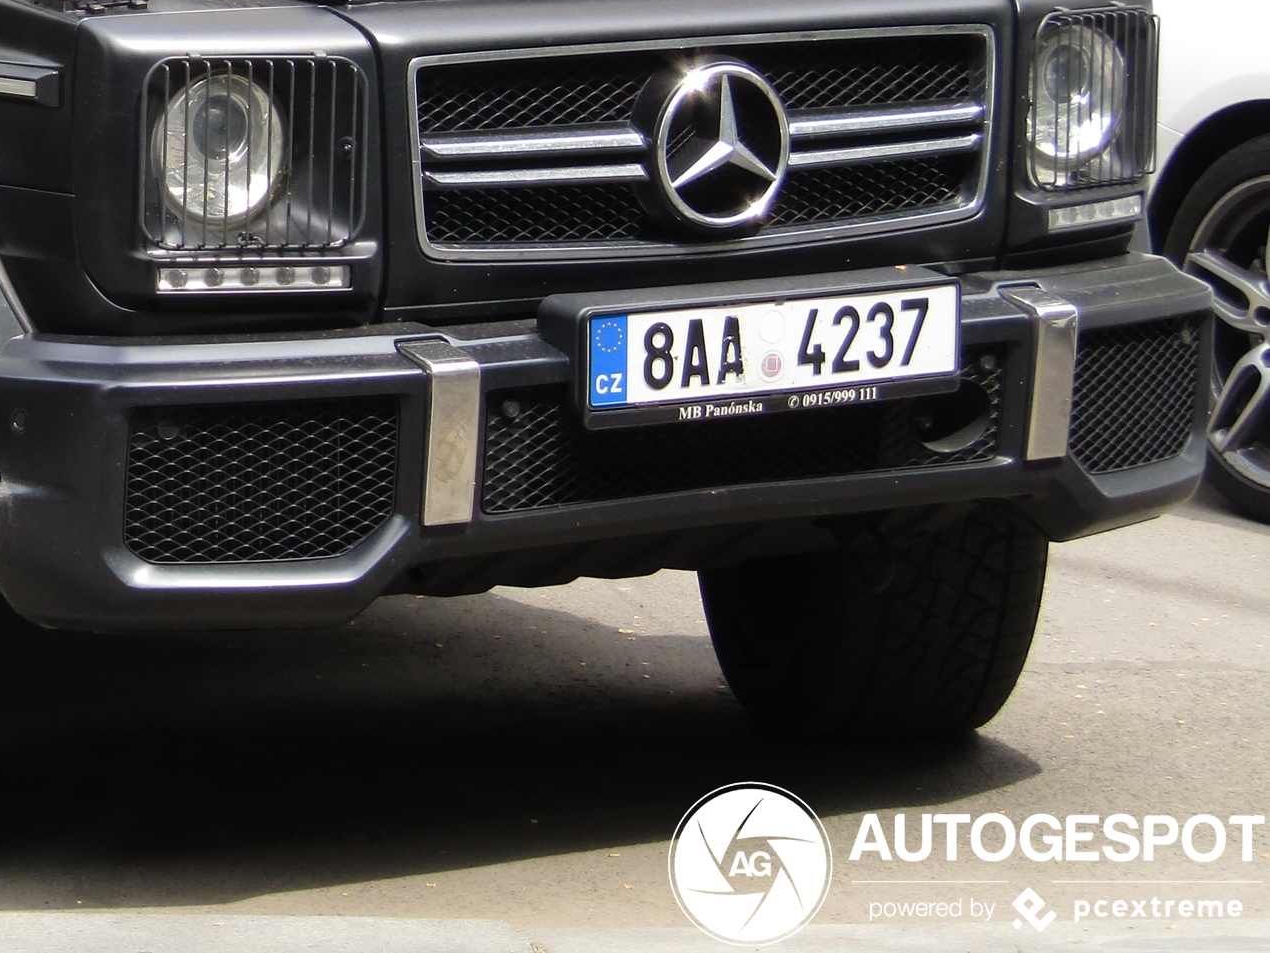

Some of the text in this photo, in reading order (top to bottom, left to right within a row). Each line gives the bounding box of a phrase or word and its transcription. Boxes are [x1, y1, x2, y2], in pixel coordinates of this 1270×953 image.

[643, 297, 929, 390] 8AA 4237
[595, 373, 623, 395] CZ
[802, 386, 878, 408] 0915/999 111
[679, 399, 763, 421] MB Panónska
